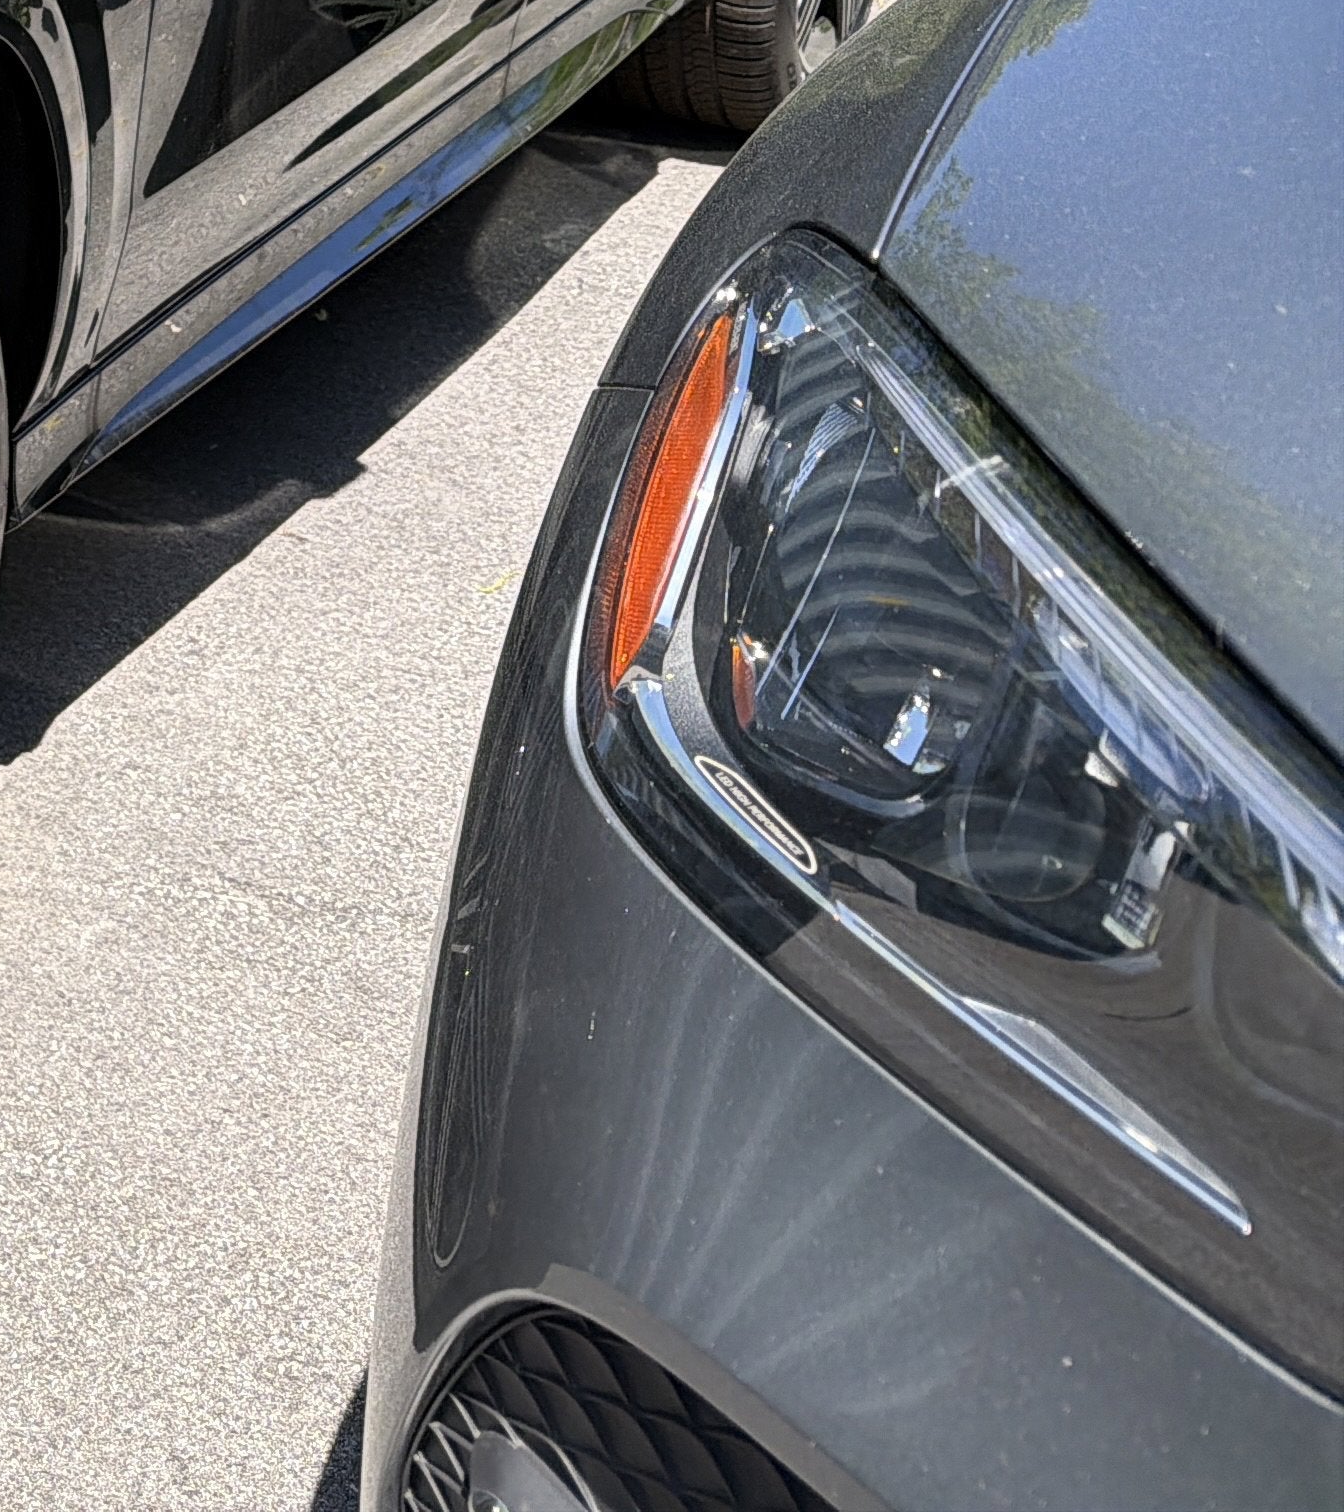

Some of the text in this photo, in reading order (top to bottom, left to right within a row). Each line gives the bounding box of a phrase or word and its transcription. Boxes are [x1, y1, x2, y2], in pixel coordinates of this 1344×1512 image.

[714, 771, 805, 856] LED HIGH PERFORMANCE
